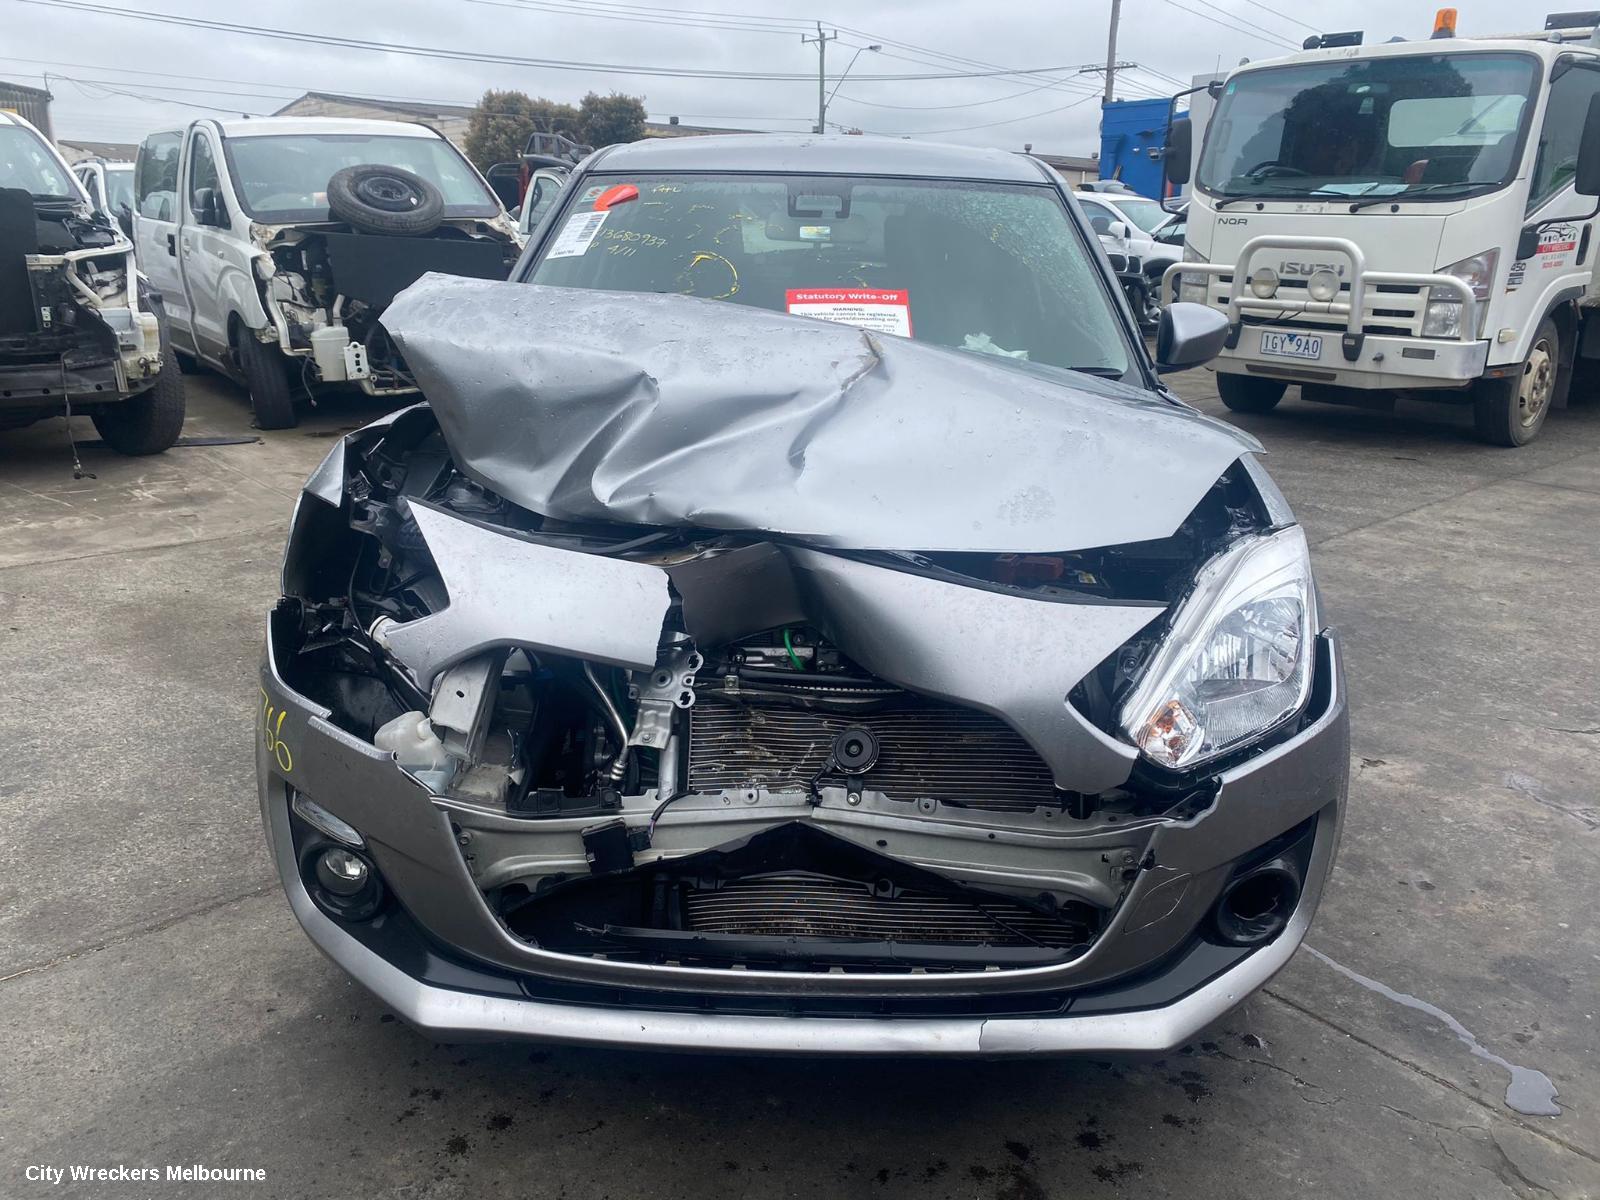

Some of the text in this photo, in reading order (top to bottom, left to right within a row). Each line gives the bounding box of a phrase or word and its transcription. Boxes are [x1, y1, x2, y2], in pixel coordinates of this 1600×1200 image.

[1217, 217, 1248, 226] NQR
[1510, 262, 1527, 272] 450
[796, 293, 898, 301] Statutory Write-Off
[1265, 335, 1287, 351] 1GY
